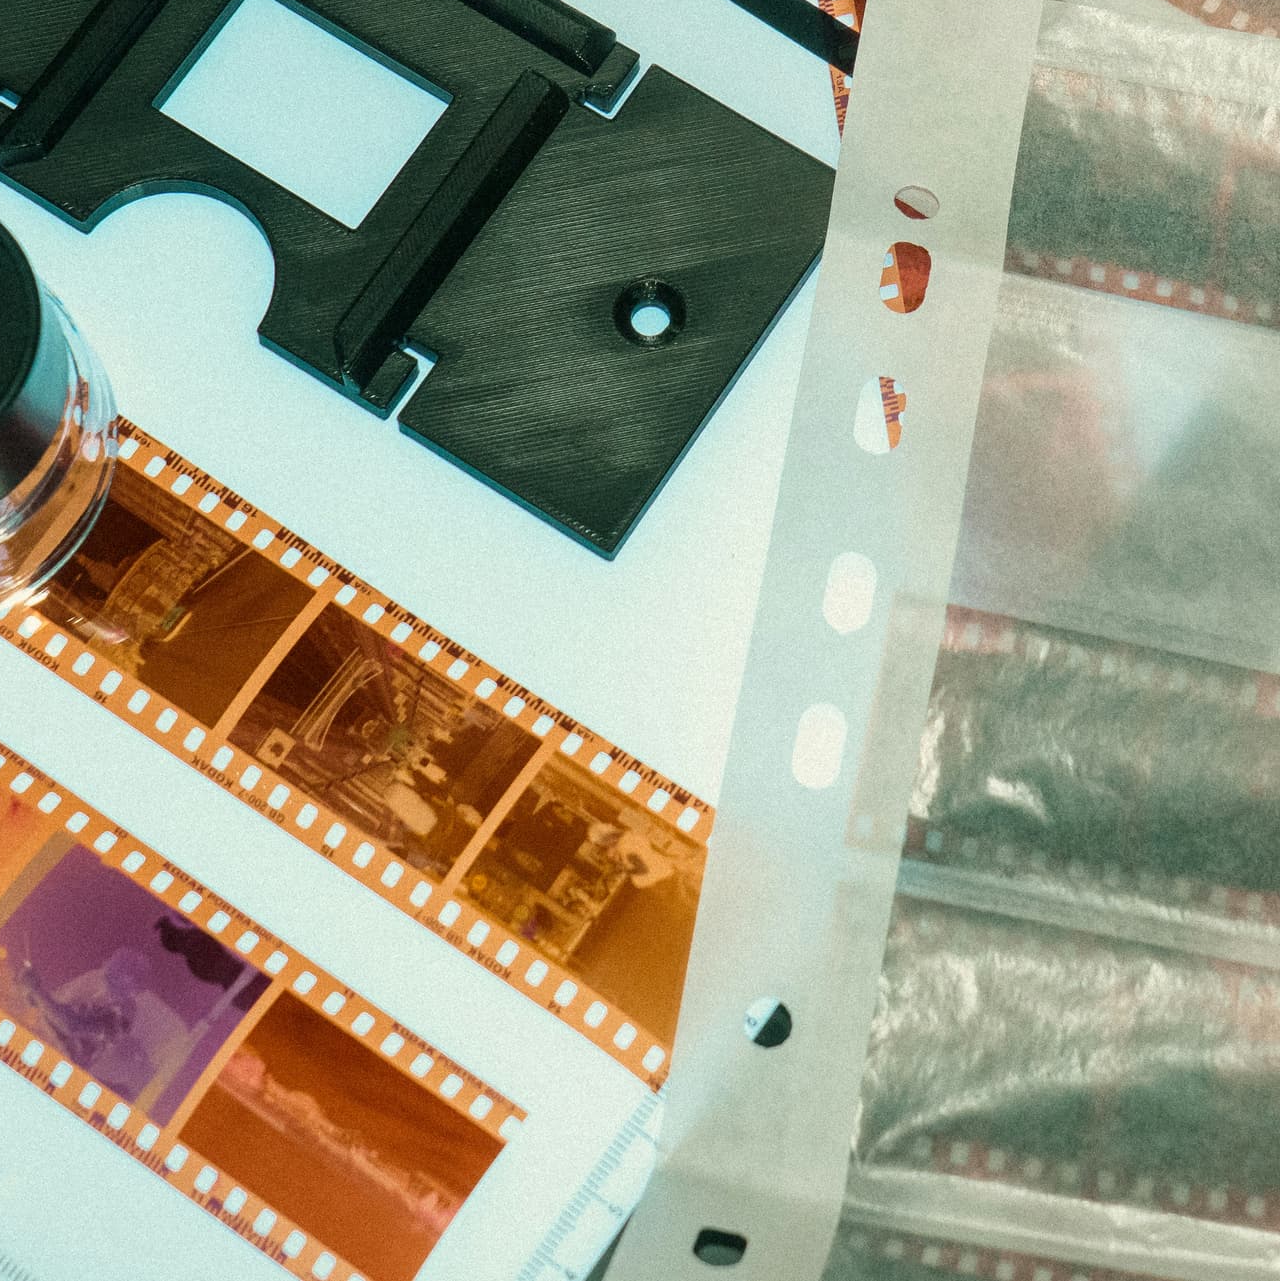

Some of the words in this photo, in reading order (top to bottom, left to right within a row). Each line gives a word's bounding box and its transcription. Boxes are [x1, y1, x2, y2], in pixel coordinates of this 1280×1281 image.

[241, 503, 258, 518] 16
[18, 639, 60, 672] KODAK
[191, 754, 234, 790] KODAK
[162, 861, 206, 894] KODAK
[207, 891, 252, 927] PORTRA
[470, 946, 512, 981] KODAK
